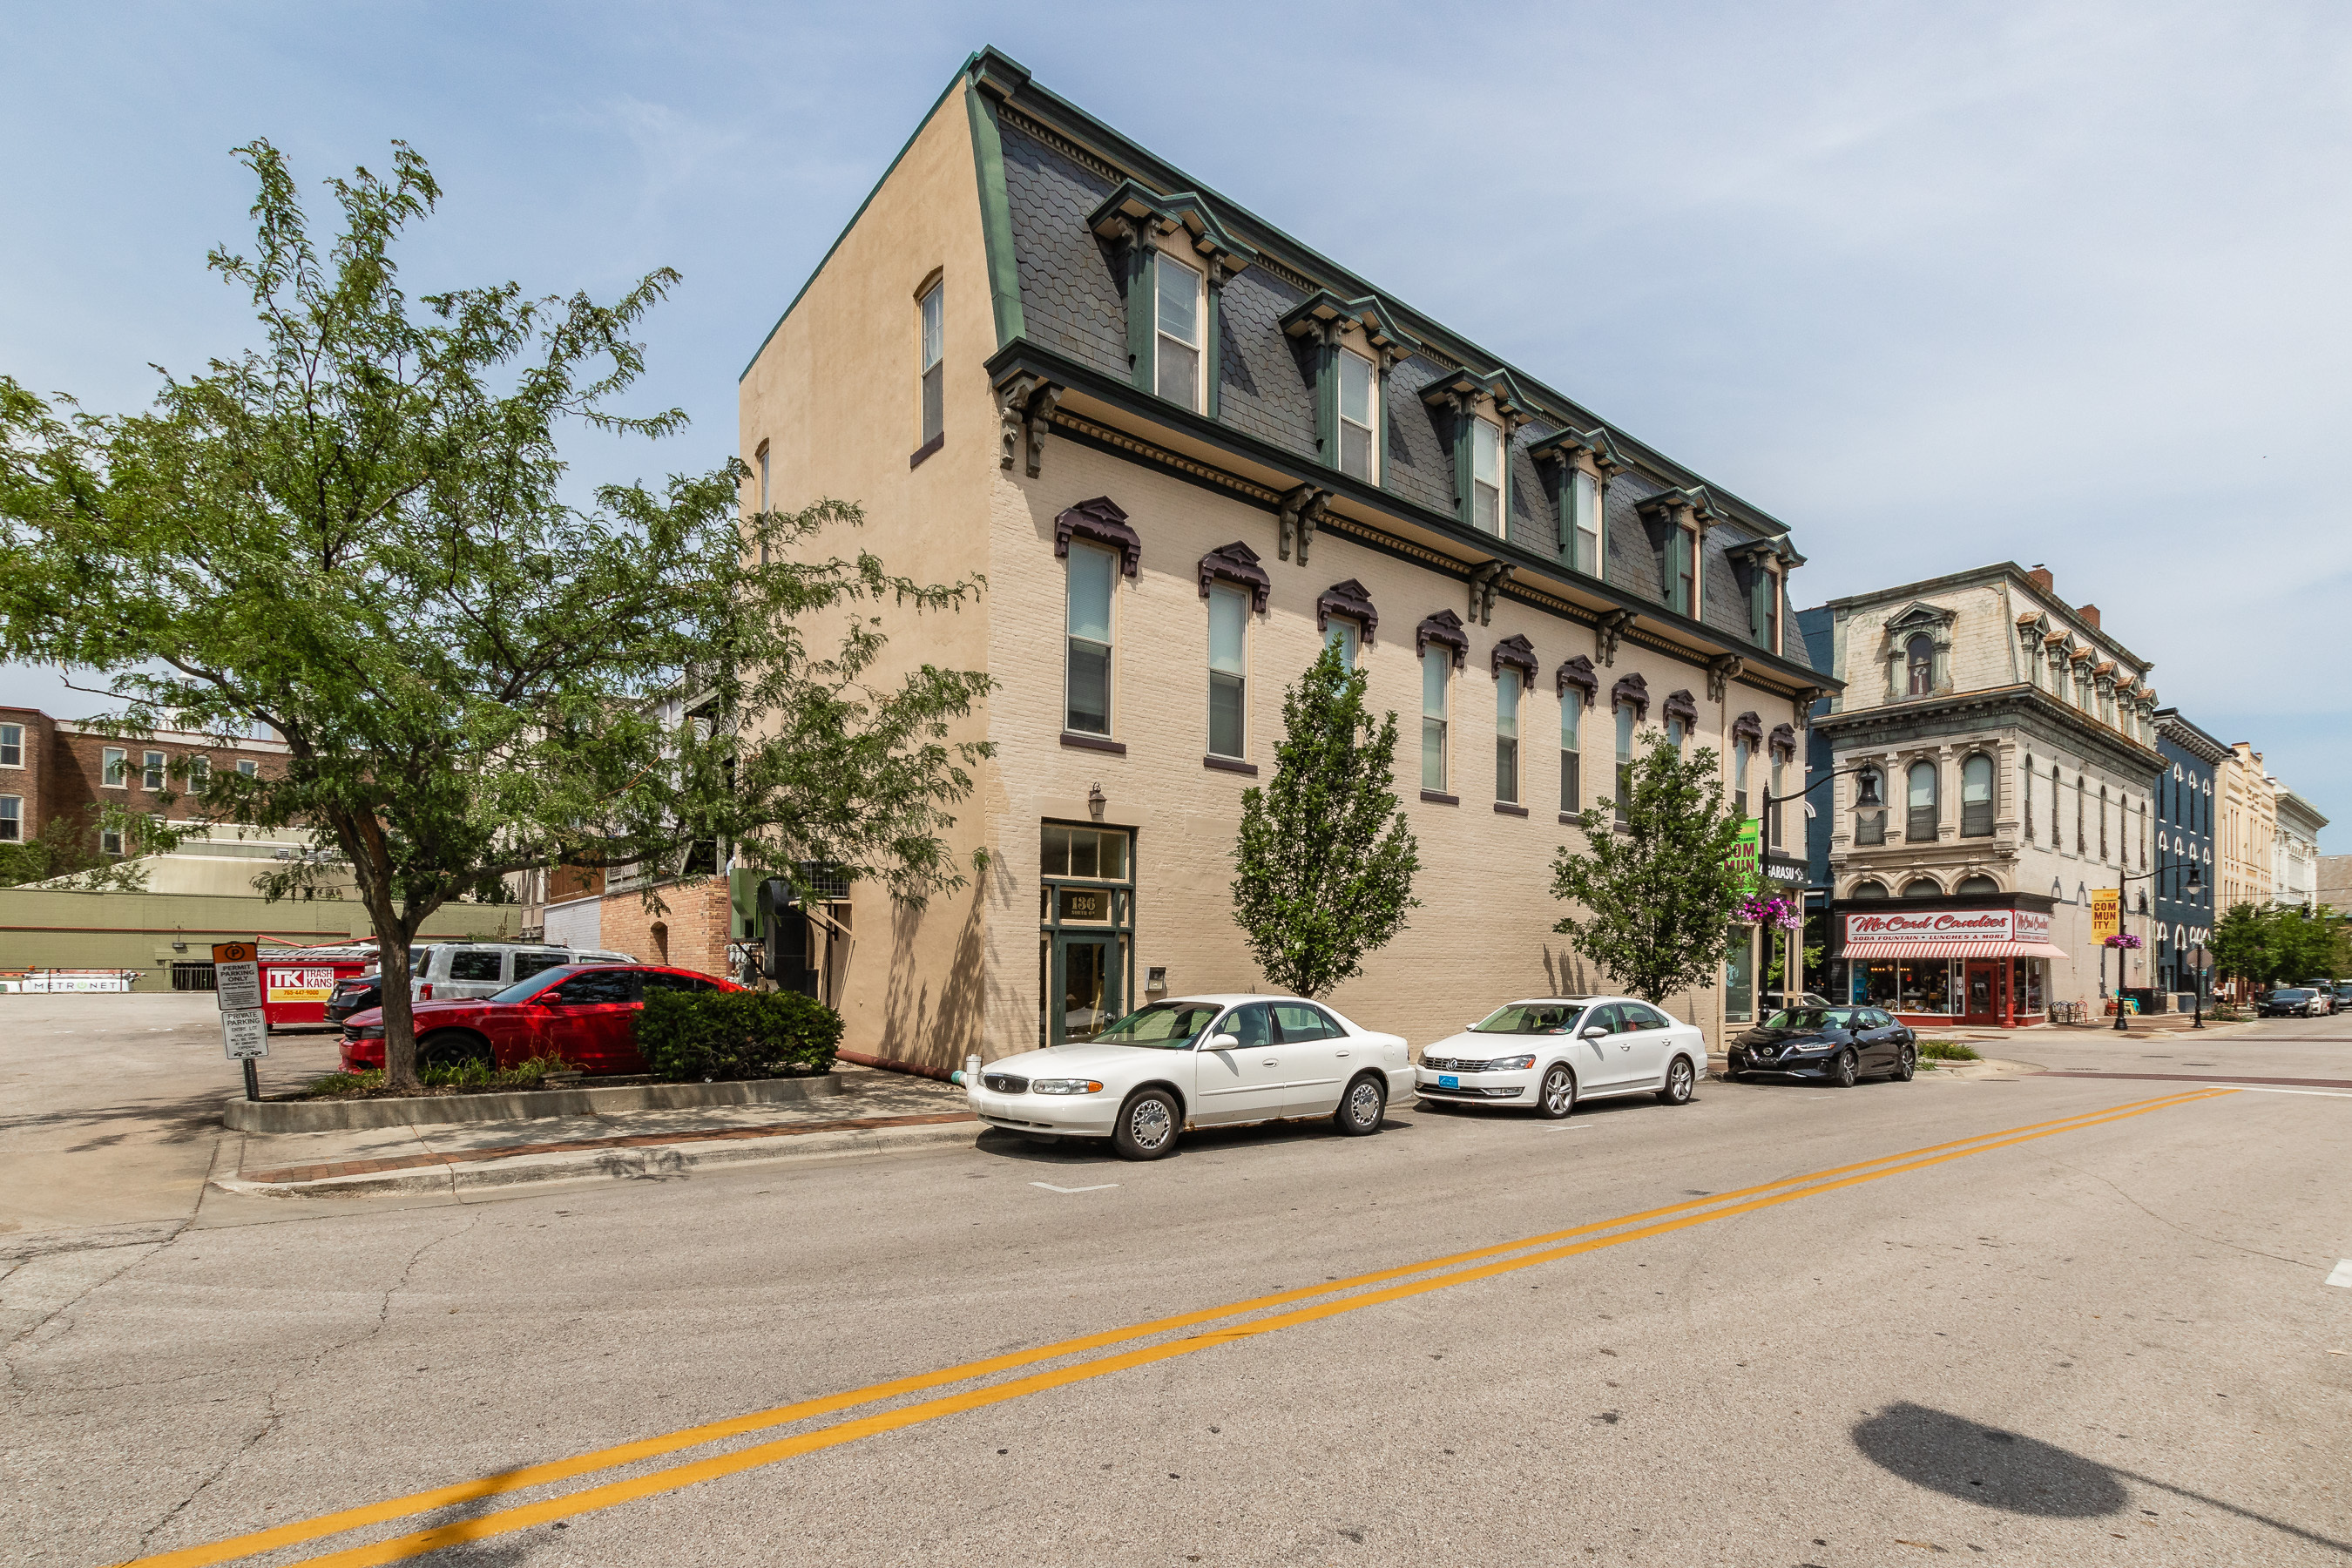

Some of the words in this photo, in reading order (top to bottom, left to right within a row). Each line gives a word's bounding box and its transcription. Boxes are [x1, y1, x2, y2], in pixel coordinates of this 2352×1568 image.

[1071, 896, 1096, 910] 136
[2094, 902, 2116, 911] COM
[2094, 911, 2116, 920] MUN
[1851, 916, 1933, 933] McCord
[1934, 915, 2008, 930] Candies
[2094, 921, 2109, 929] ITY
[306, 969, 333, 978] TRASH
[271, 970, 304, 987] TK
[307, 978, 332, 988] KANS
